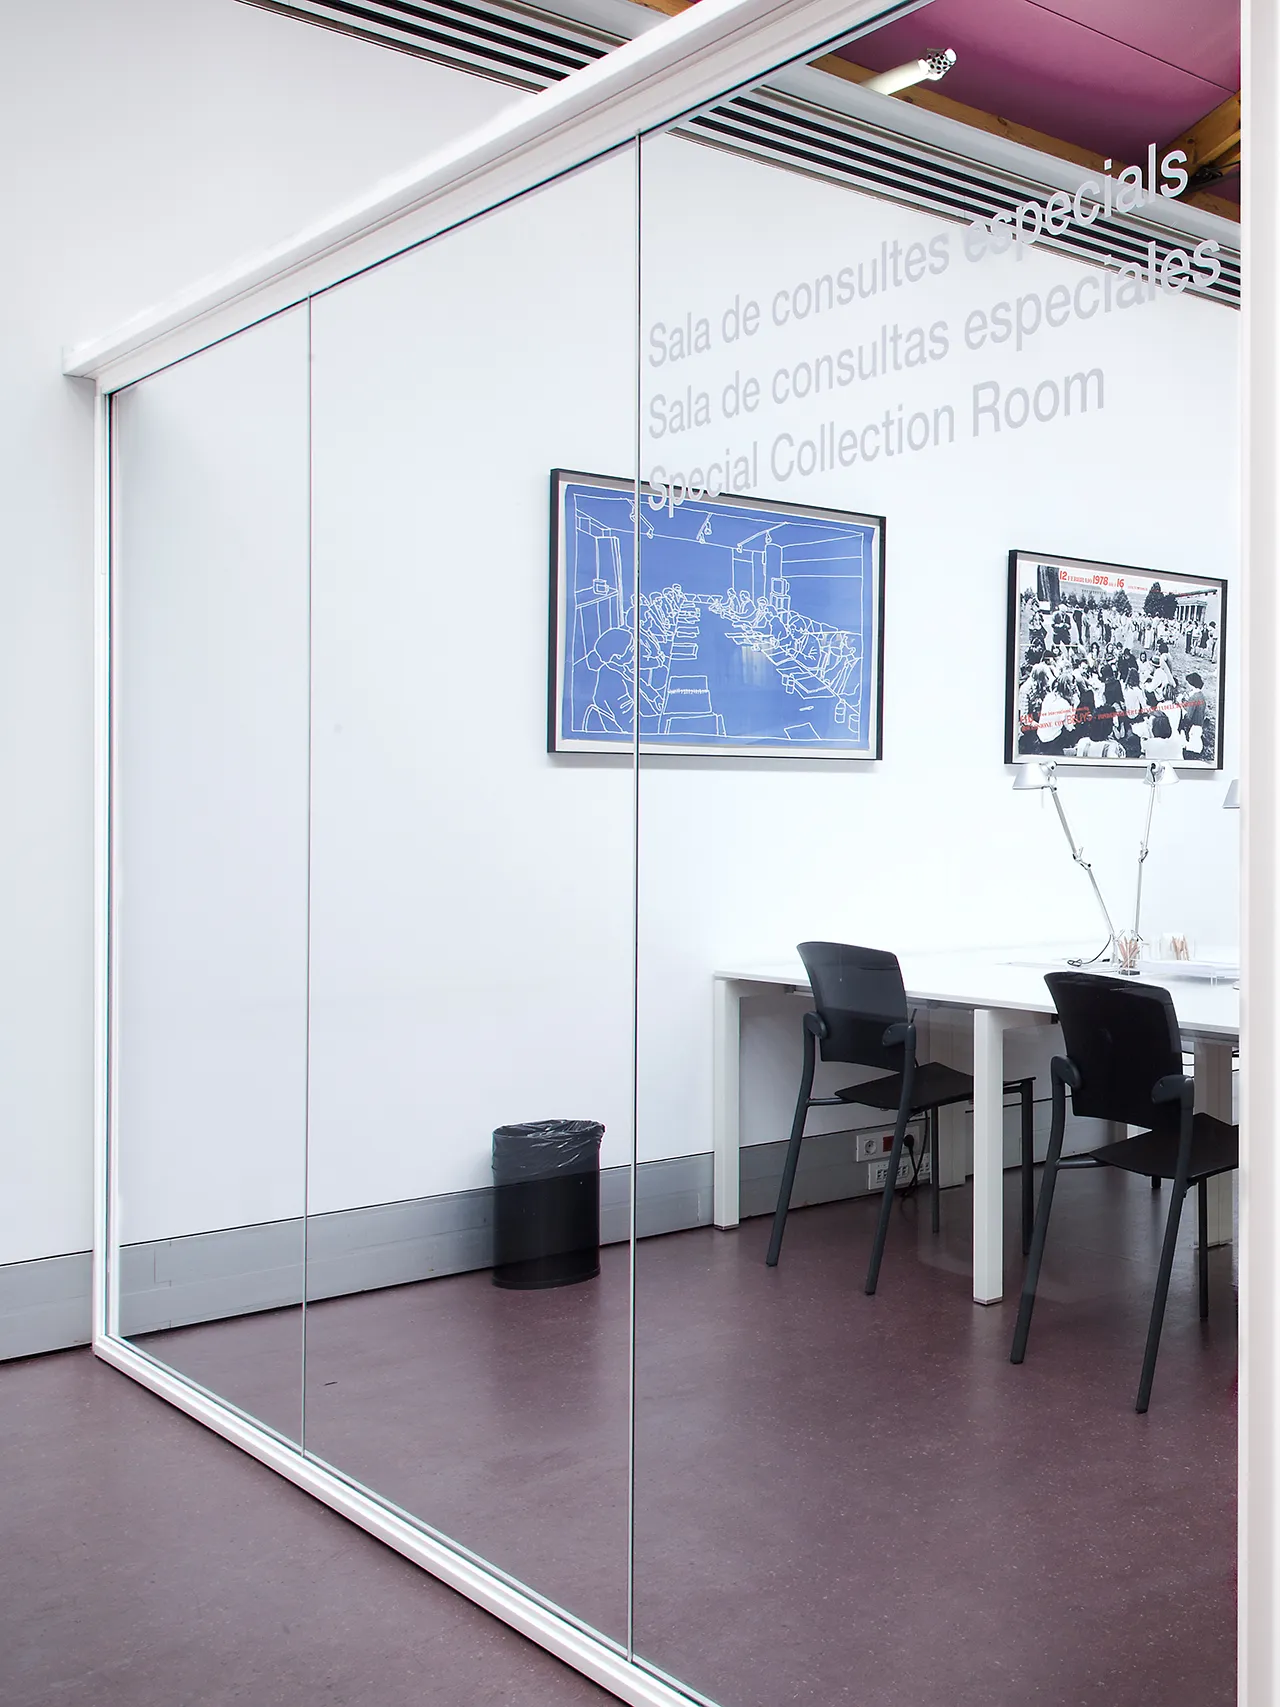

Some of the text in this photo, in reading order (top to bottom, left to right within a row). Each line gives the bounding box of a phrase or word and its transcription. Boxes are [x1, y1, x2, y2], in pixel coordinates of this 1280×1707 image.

[648, 143, 1189, 368] Sala de consultes especials
[648, 239, 1221, 439] Sala de consultas especiales
[647, 367, 1104, 519] Special Collection Room
[1059, 570, 1068, 581] 12
[1092, 575, 1109, 586] 1978
[1117, 578, 1125, 588] 16
